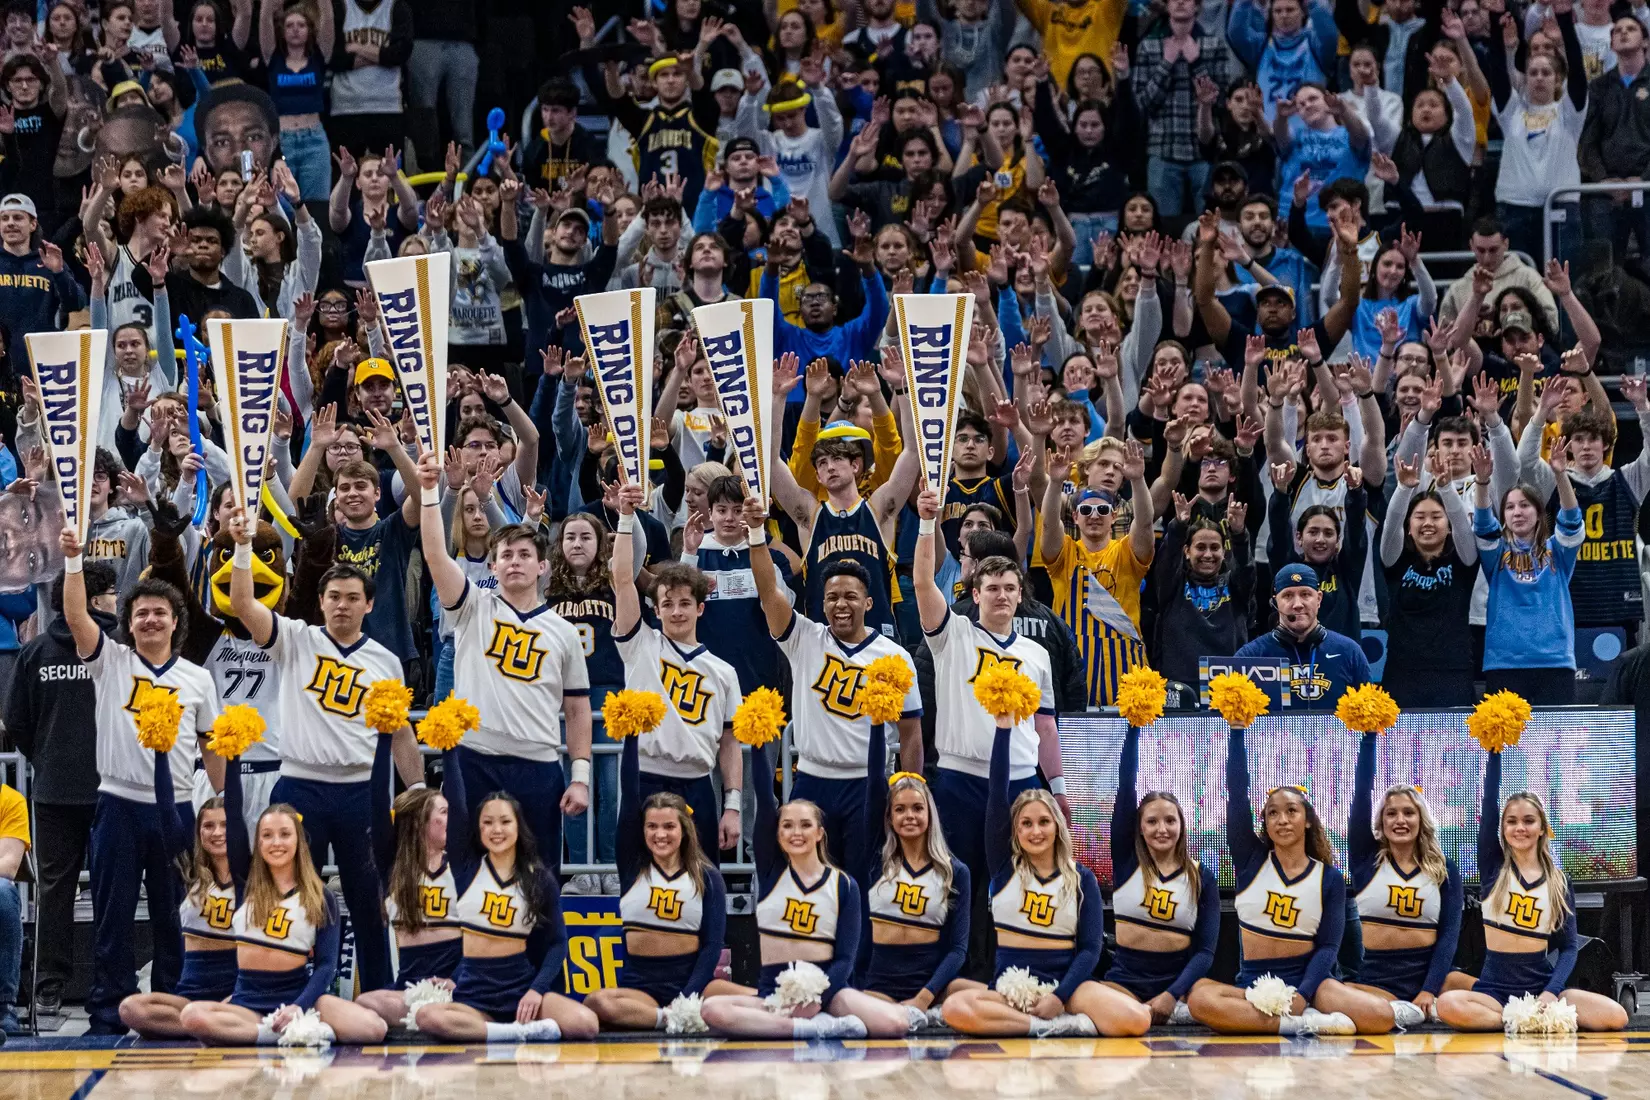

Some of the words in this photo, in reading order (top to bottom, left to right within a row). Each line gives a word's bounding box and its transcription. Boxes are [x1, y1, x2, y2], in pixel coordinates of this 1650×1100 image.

[660, 150, 678, 175] 3
[133, 304, 154, 327] 3
[378, 288, 423, 373] RING
[407, 383, 432, 453] OUT
[910, 324, 952, 408] RING
[237, 350, 277, 433] RING
[590, 320, 632, 405] RING
[613, 415, 640, 484] OUT
[703, 330, 749, 416] RING
[732, 425, 761, 493] OUT
[37, 361, 77, 446] RING
[57, 455, 78, 525] OUT
[921, 418, 943, 487] OUT
[817, 534, 881, 564] MARQUETTE
[551, 599, 614, 622] MARQUETTE
[1012, 616, 1049, 639] RITY
[485, 618, 550, 684] MU
[222, 668, 265, 699] 77
[305, 655, 372, 719] MU
[659, 657, 715, 726] MU
[810, 652, 870, 720] MU
[199, 896, 238, 930] MU
[480, 890, 519, 929] MU
[645, 886, 685, 922] MU
[782, 896, 820, 936] MU
[893, 880, 931, 917] MU
[1018, 884, 1058, 928] MU
[1137, 885, 1179, 922] MU
[1262, 889, 1302, 931] MU
[1387, 883, 1426, 920] MU
[1504, 891, 1545, 930] MU
